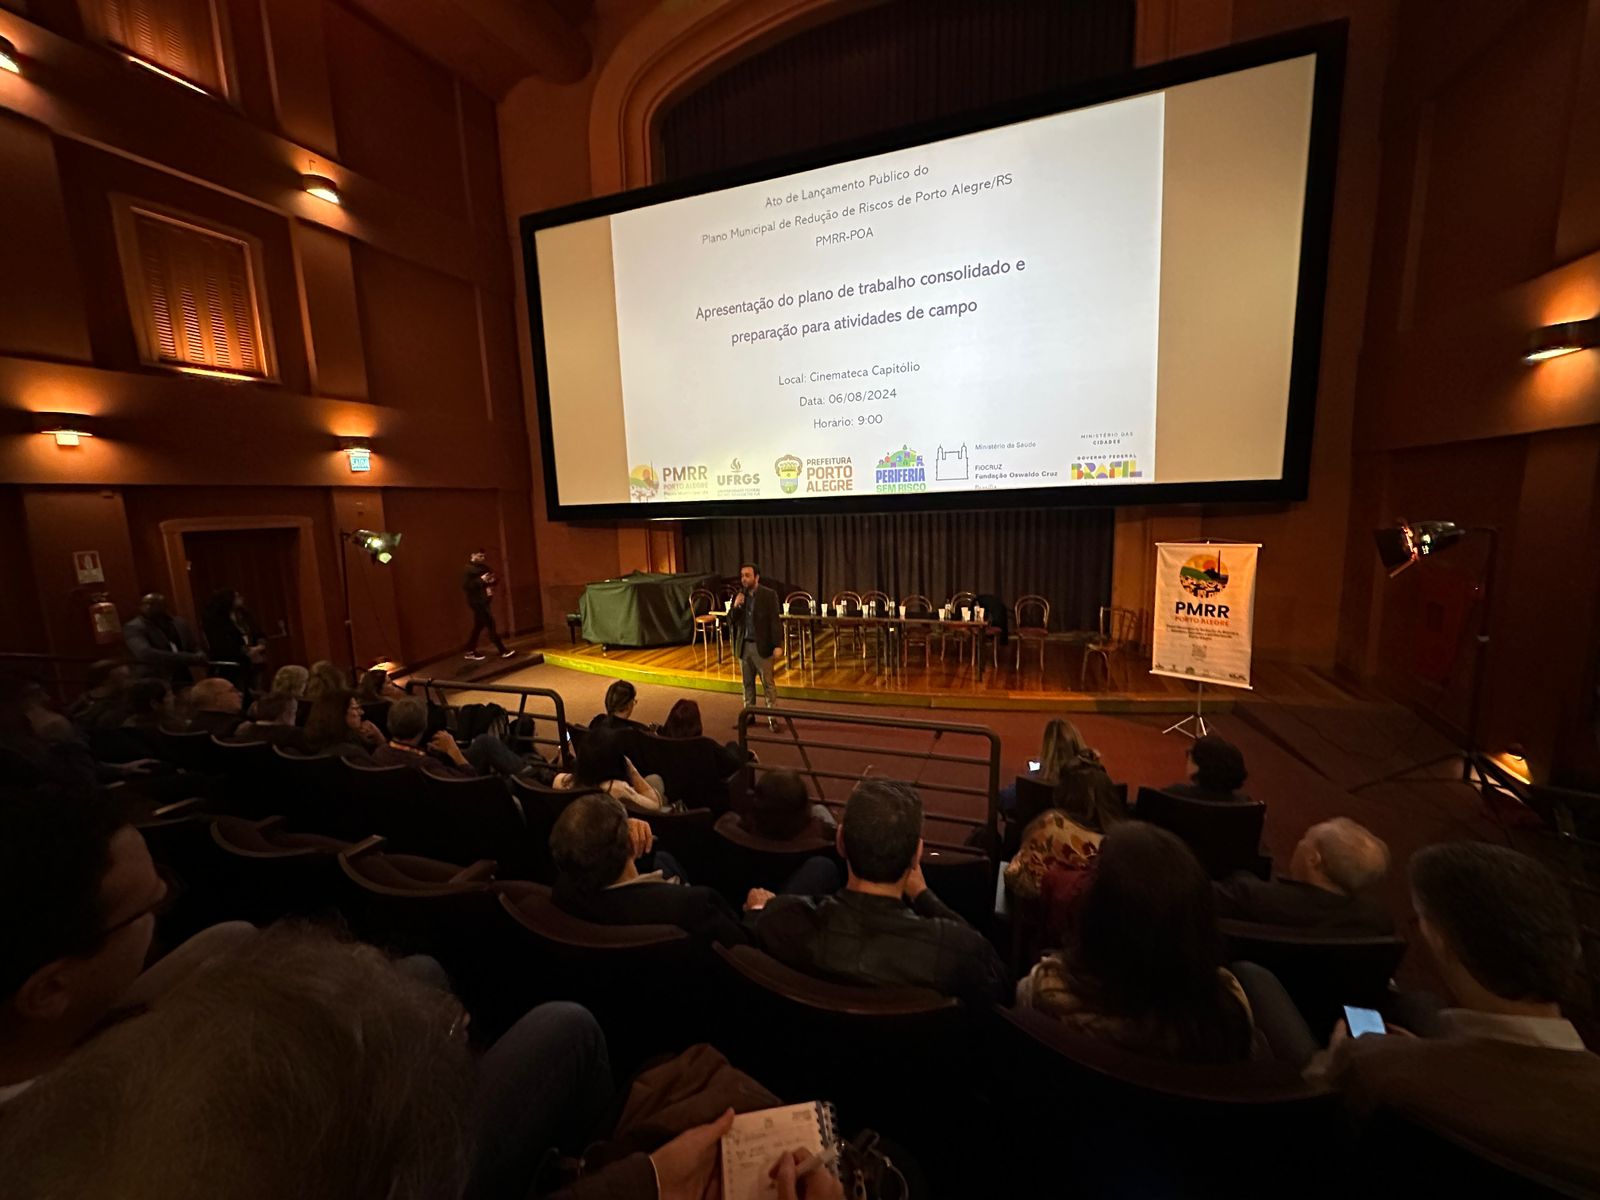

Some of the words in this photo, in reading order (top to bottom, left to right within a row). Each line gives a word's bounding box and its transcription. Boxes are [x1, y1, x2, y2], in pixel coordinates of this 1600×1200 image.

[765, 197, 783, 208] Ato
[785, 193, 799, 204] de
[801, 180, 865, 200] Lançamento
[913, 165, 929, 177] do
[701, 234, 728, 245] Plano
[730, 221, 776, 239] Municipal
[779, 218, 792, 230] de
[794, 210, 839, 226] Redução
[841, 206, 856, 217] de
[859, 200, 894, 214] Riscos
[897, 195, 912, 206] de
[915, 189, 947, 203] Porto
[951, 173, 1013, 196] Alegre/RS
[815, 227, 874, 247] PMRR-POA
[696, 296, 774, 321] Apresentação
[778, 293, 794, 308] do
[798, 289, 833, 308] plano
[837, 284, 854, 298] de
[859, 275, 916, 295] trabalho
[920, 260, 1011, 286] consolidado
[1015, 260, 1026, 271] e
[731, 324, 798, 347] preparação
[802, 320, 830, 338] para
[833, 310, 902, 330] atividades
[906, 306, 924, 320] de
[928, 301, 978, 318] campo
[778, 373, 807, 386] Local:
[809, 368, 869, 382] Cinemateca
[871, 361, 920, 377] Capitólio
[799, 396, 825, 407] Data:
[828, 388, 897, 405] 06/08/2024
[857, 414, 883, 426] 9:00
[975, 442, 1006, 450] Ministério
[806, 457, 852, 466] PREFEITURA
[1071, 460, 1143, 480] BRASIL
[662, 465, 708, 482] PMRR
[717, 473, 760, 486] UFRGS
[806, 465, 853, 480] PORTO
[875, 468, 926, 484] PERIFERIA
[975, 472, 1007, 480] Fundação
[806, 479, 853, 492] ALEGRE
[897, 483, 926, 492] RISCO
[1175, 601, 1230, 619] PMRR
